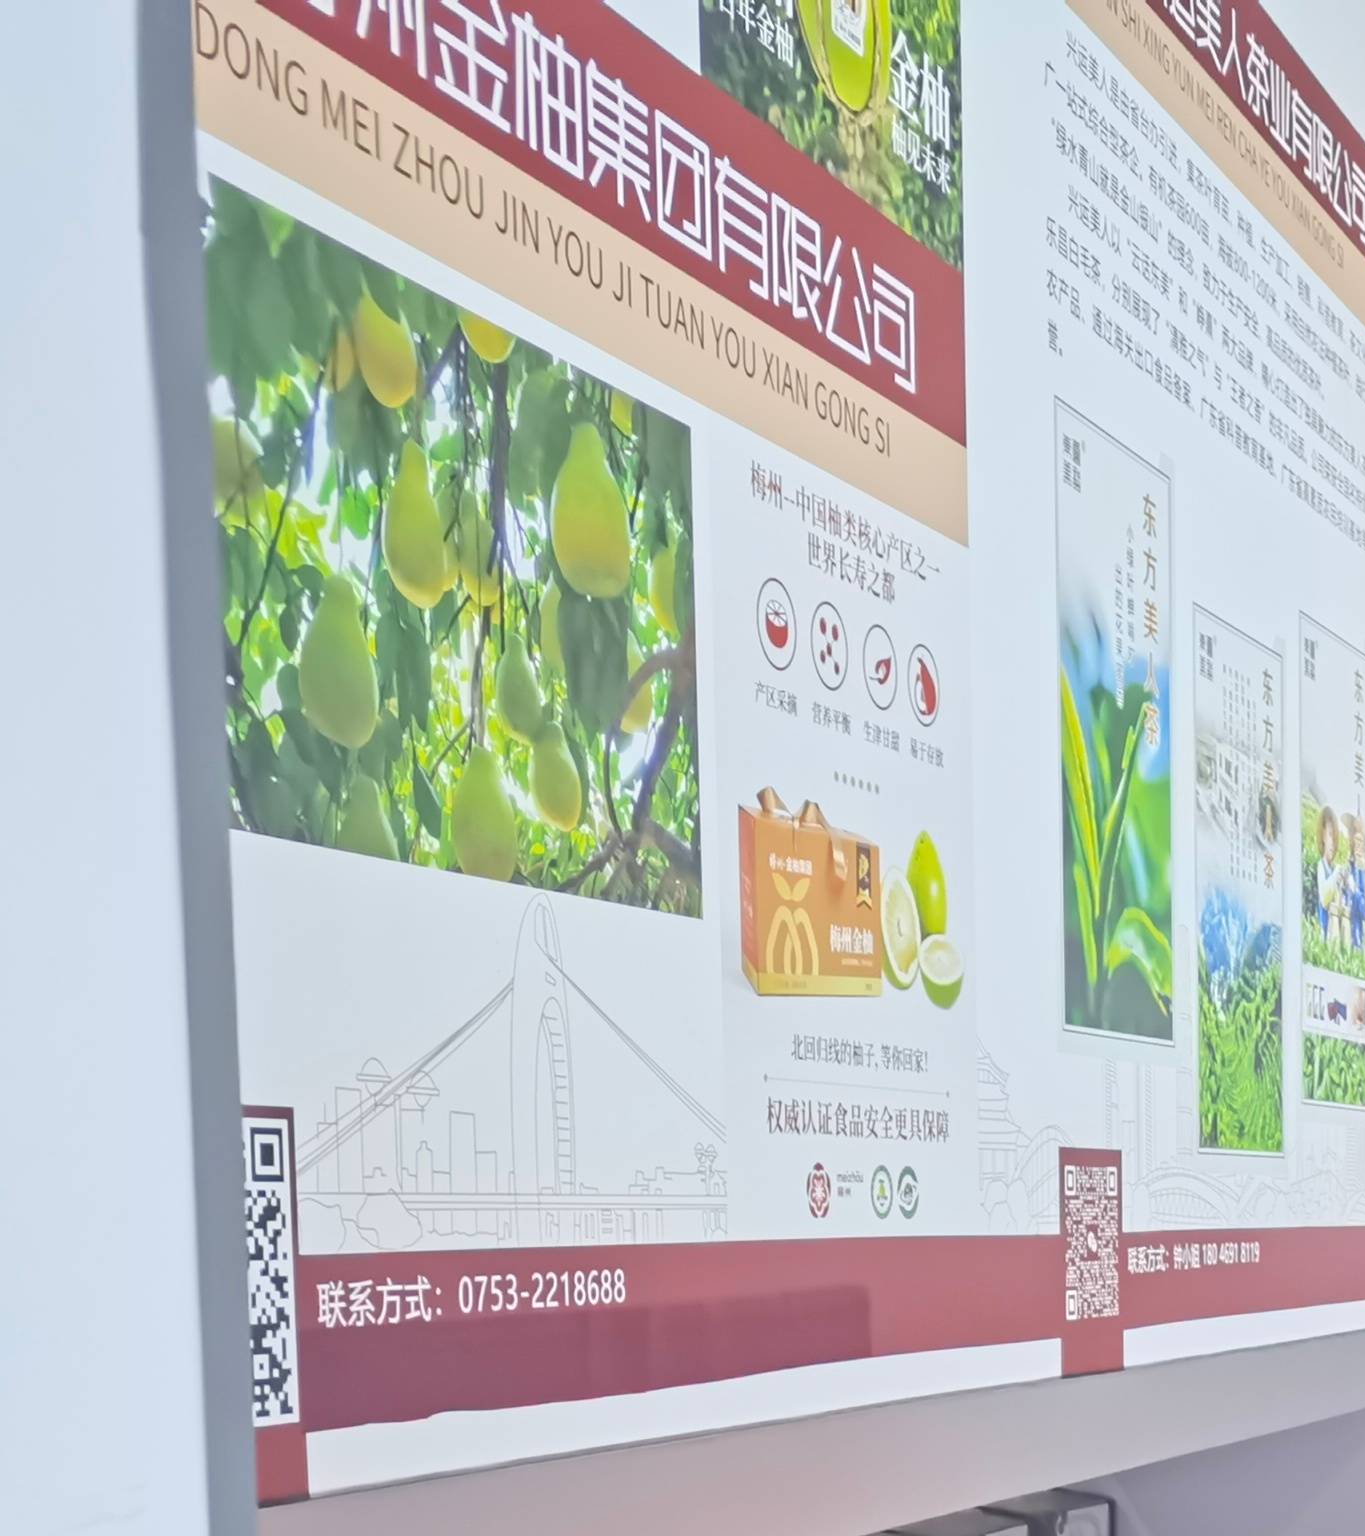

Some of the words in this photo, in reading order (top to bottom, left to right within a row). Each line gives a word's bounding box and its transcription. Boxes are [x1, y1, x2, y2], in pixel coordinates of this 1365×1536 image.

[888, 29, 951, 150] 金柚
[891, 115, 951, 193] 柚见未来
[195, 4, 308, 116] DONG
[320, 78, 382, 161] MEI
[391, 121, 485, 220] ZHOU
[493, 189, 540, 257] JIN
[547, 217, 605, 290] YOU
[612, 258, 634, 310] JI
[639, 271, 706, 353] TUAN
[711, 316, 757, 378] YOU
[762, 344, 810, 413] XIAN
[815, 376, 870, 444] GONG
[874, 408, 891, 458] SI
[807, 532, 896, 603] 世界长寿之都
[1142, 493, 1160, 747] 东方美人茶
[767, 1096, 950, 1143] 权威认证食品安全更具保障
[457, 1267, 627, 1314] 0753-2218688
